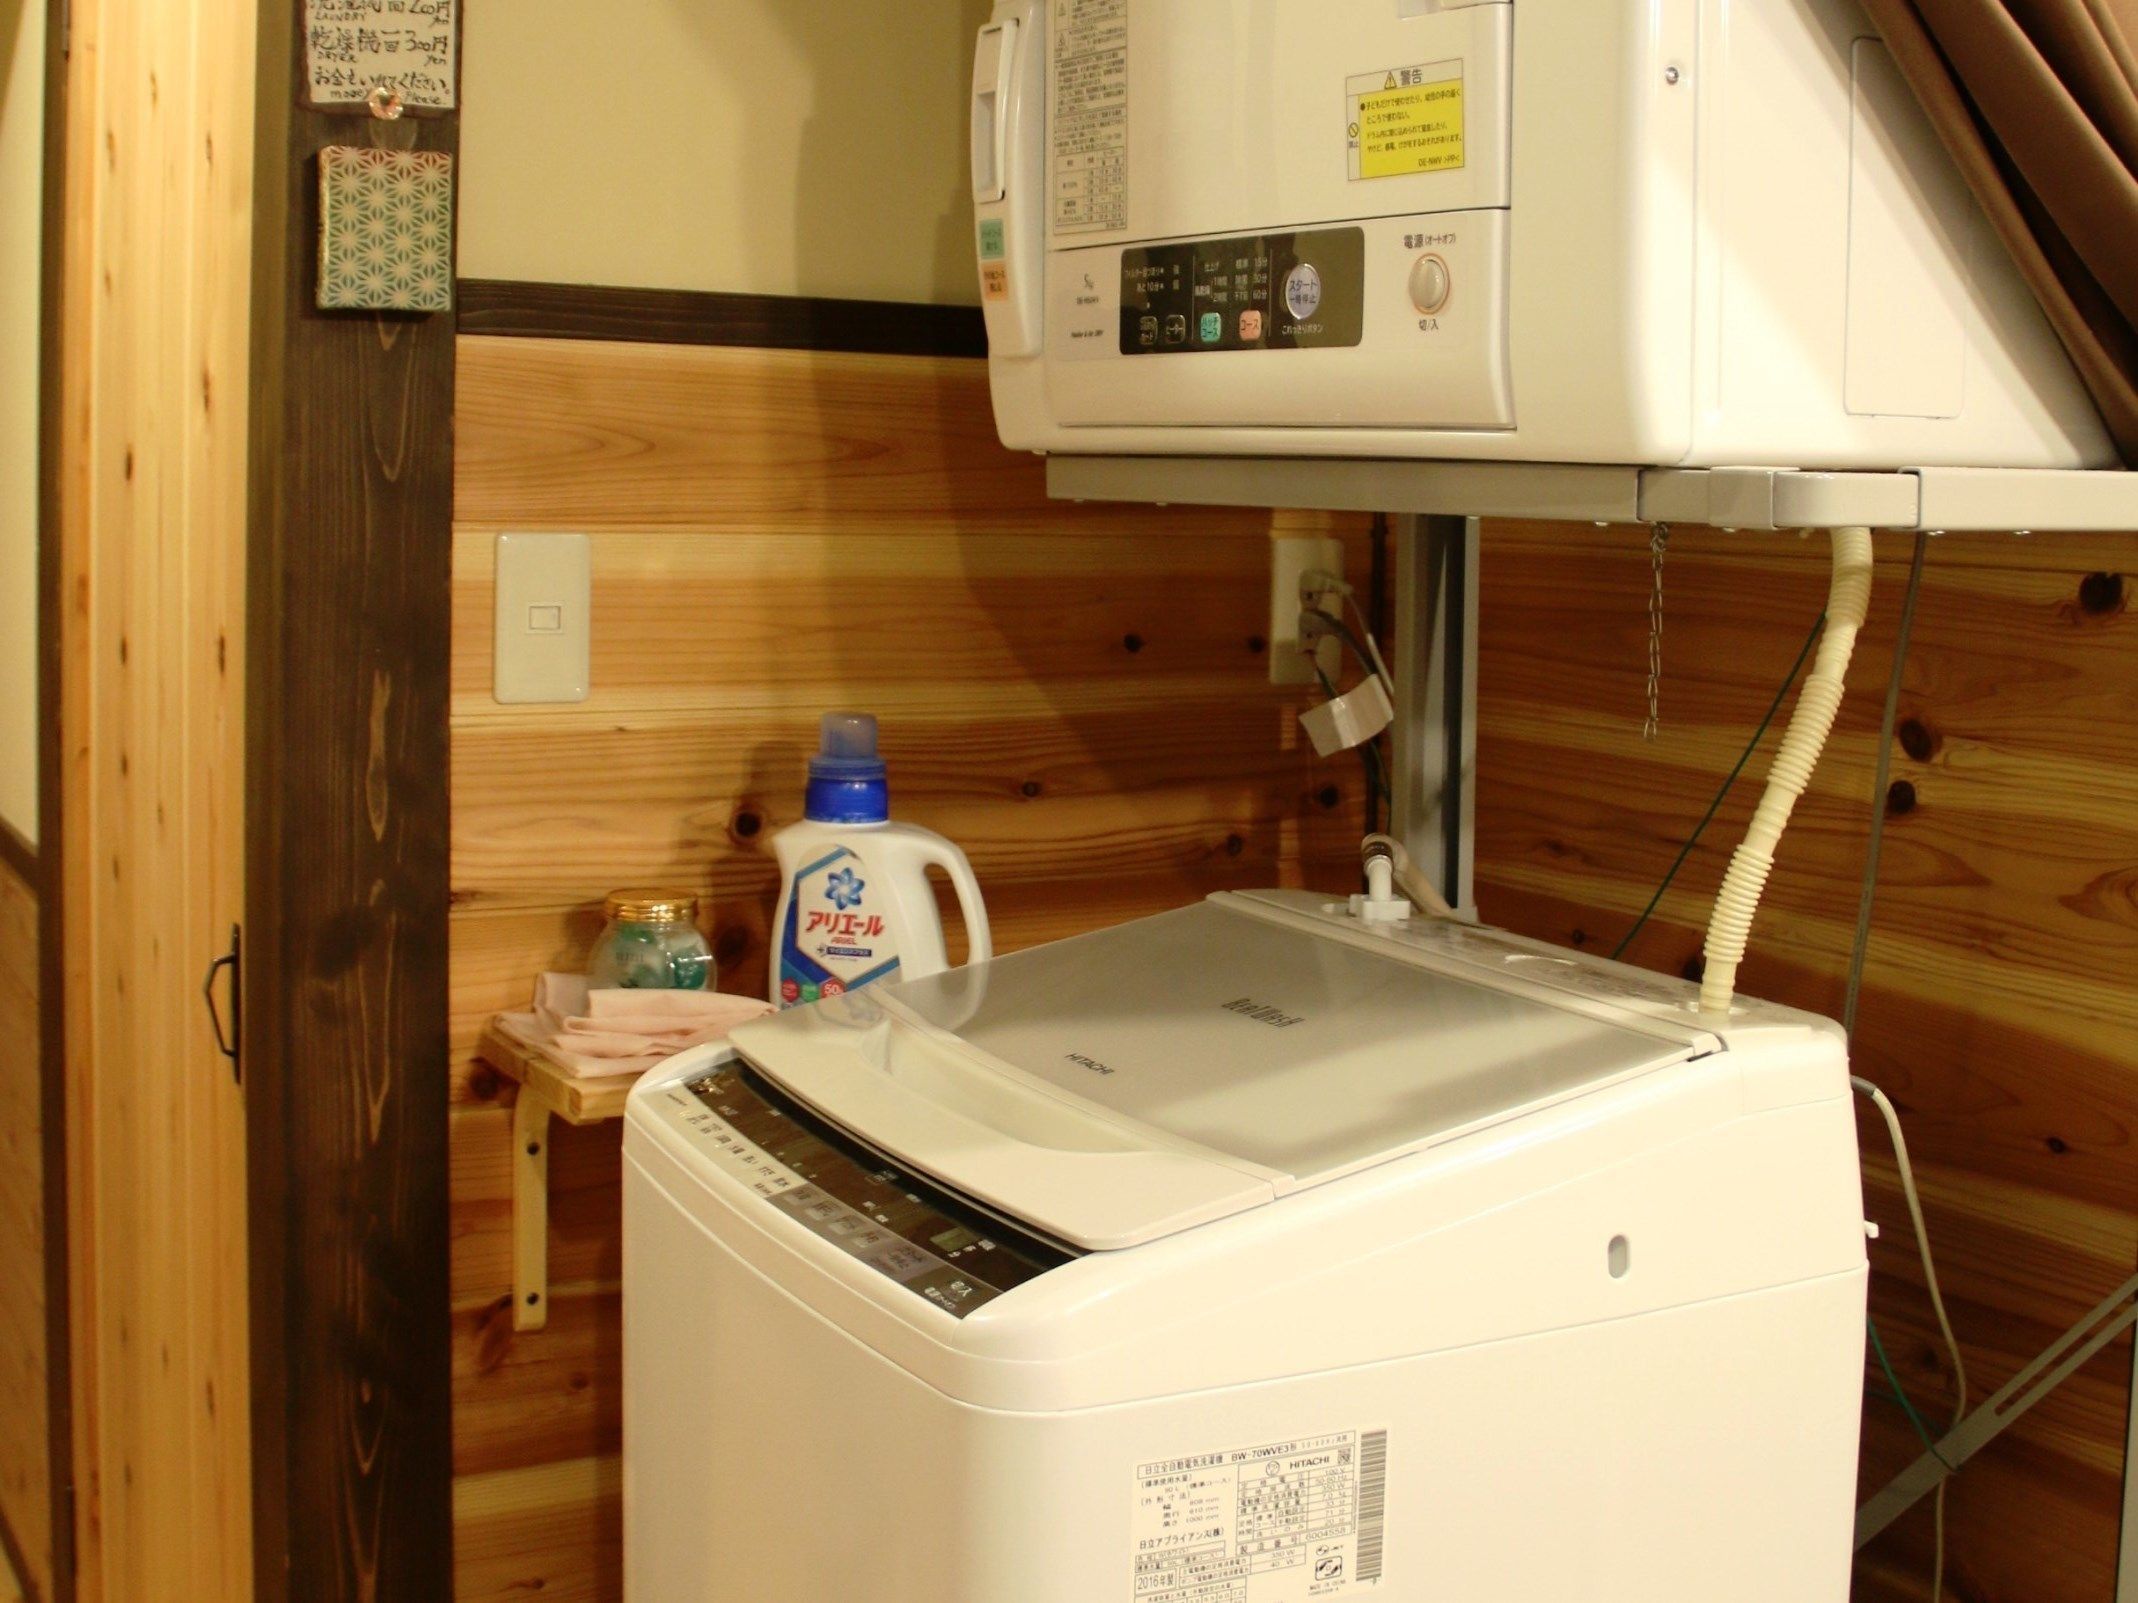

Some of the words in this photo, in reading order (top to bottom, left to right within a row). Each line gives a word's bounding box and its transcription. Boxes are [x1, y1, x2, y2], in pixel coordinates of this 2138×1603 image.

[1400, 69, 1422, 86] 警告
[1289, 279, 1318, 291] スタート
[805, 911, 885, 937] アリエール
[1064, 1052, 1115, 1075] HITACHI
[1289, 1455, 1329, 1469] HITACHI
[1137, 1571, 1174, 1591] 2016年製
